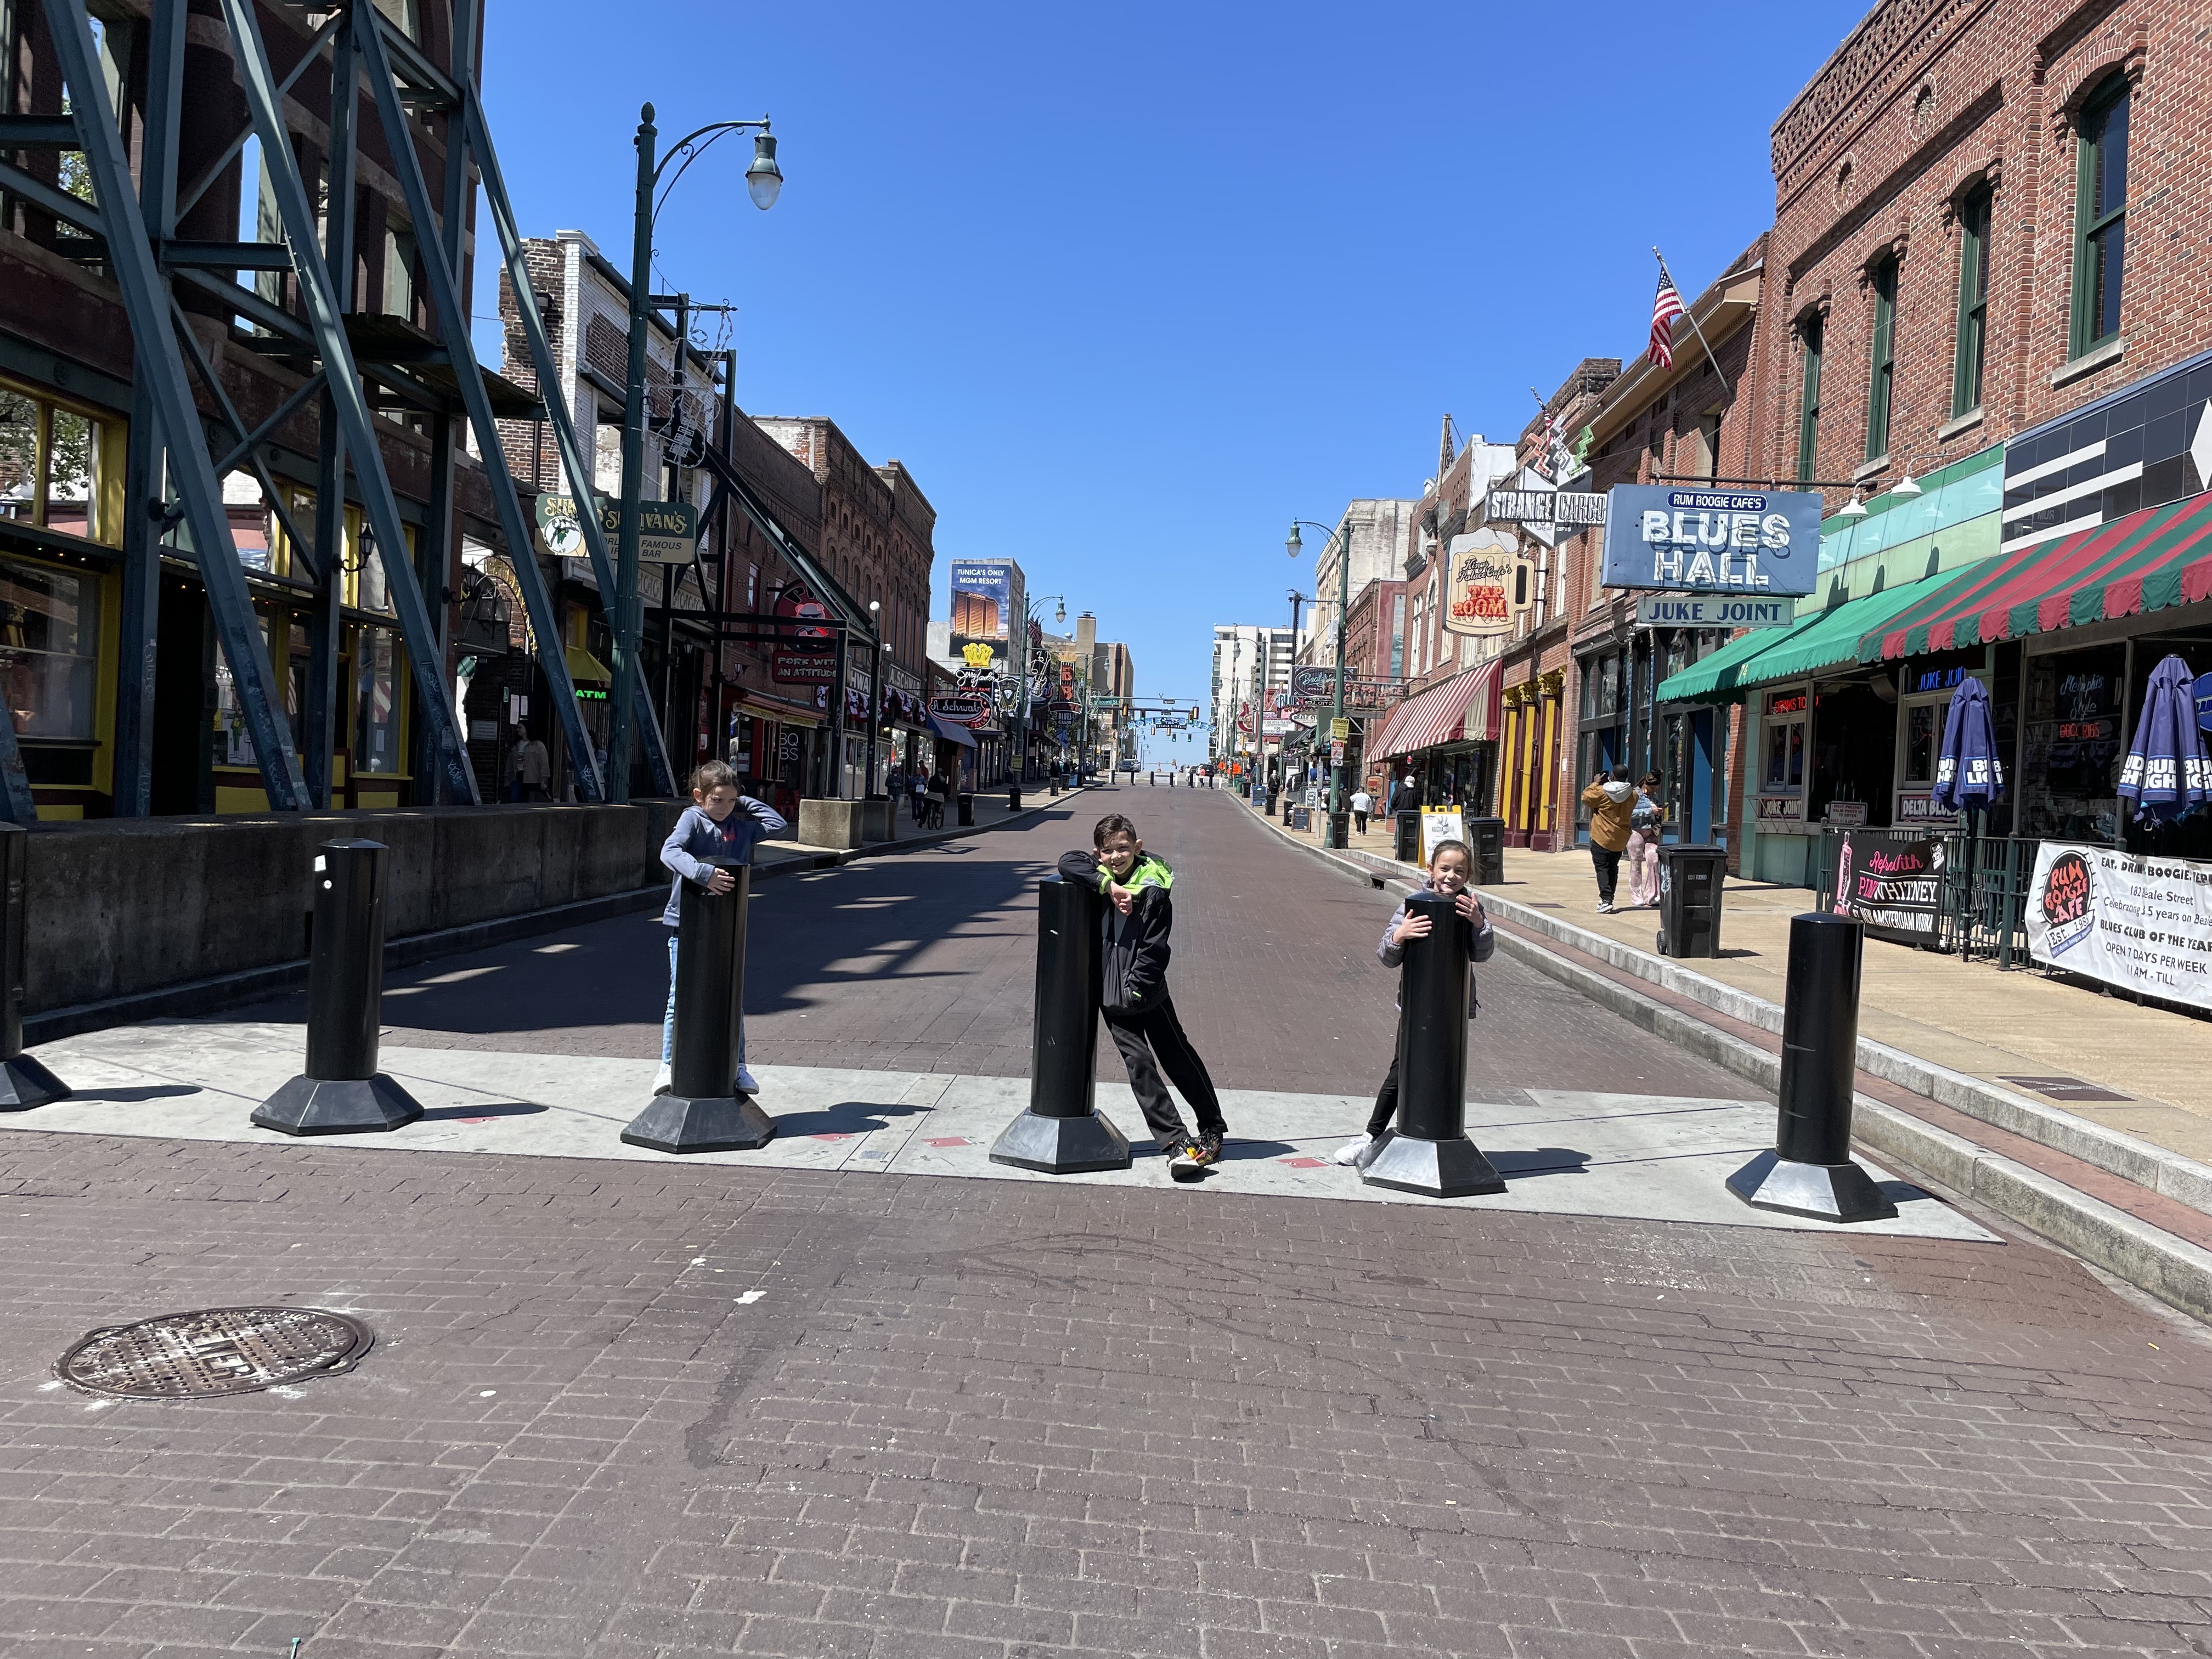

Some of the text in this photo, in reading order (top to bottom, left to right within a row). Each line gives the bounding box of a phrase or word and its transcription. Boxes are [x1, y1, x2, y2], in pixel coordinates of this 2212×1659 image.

[544, 497, 576, 516] SILK
[1491, 492, 1605, 521] STRANGE CARGO
[1673, 494, 1762, 509] RUM BOOGIE CAFE'S
[1643, 510, 1791, 549] BLUES
[641, 540, 682, 550] FAMOUS
[641, 549, 662, 558] BAR
[1457, 564, 1513, 583] Palace Cafe's
[1654, 550, 1769, 586] HALL
[1469, 585, 1504, 599] TAP
[1453, 599, 1507, 617] ROOM
[1648, 602, 1782, 621] JUKE JOINT
[777, 657, 809, 665] PORK
[777, 668, 791, 676] AN
[1918, 670, 1941, 691] JUKE
[576, 690, 606, 699] ATM
[2060, 674, 2104, 699] Memphis
[943, 700, 982, 712] Schwab
[1798, 696, 1806, 709] TO
[2070, 697, 2097, 721] Style
[2082, 723, 2100, 738] RIBS
[2124, 755, 2144, 771] UD
[2143, 774, 2176, 789] IGH
[1767, 800, 1801, 815] JUKE JOINT
[1903, 799, 1927, 816] DELTA
[1870, 850, 1893, 874] Refre
[2051, 860, 2084, 890] RUM
[2148, 866, 2192, 881] BOOGIE.
[2045, 877, 2087, 910] BOOGIE
[2130, 885, 2141, 896] 182
[2166, 891, 2194, 906] Street
[1860, 907, 1875, 924] NEW
[1915, 913, 1933, 933] VODKA
[2104, 896, 2141, 917] Celebrating
[2155, 909, 2180, 921] years
[2182, 914, 2192, 923] on
[2194, 913, 2212, 927] Beale
[2049, 927, 2070, 945] Est.
[2100, 919, 2123, 934] BLUES
[2124, 926, 2146, 939] CLUB
[2149, 931, 2166, 943] OF
[2168, 934, 2186, 948] THE
[2106, 942, 2208, 974] OPEN 7 DAYS PER WEEK
[2156, 970, 2175, 986] TILL
